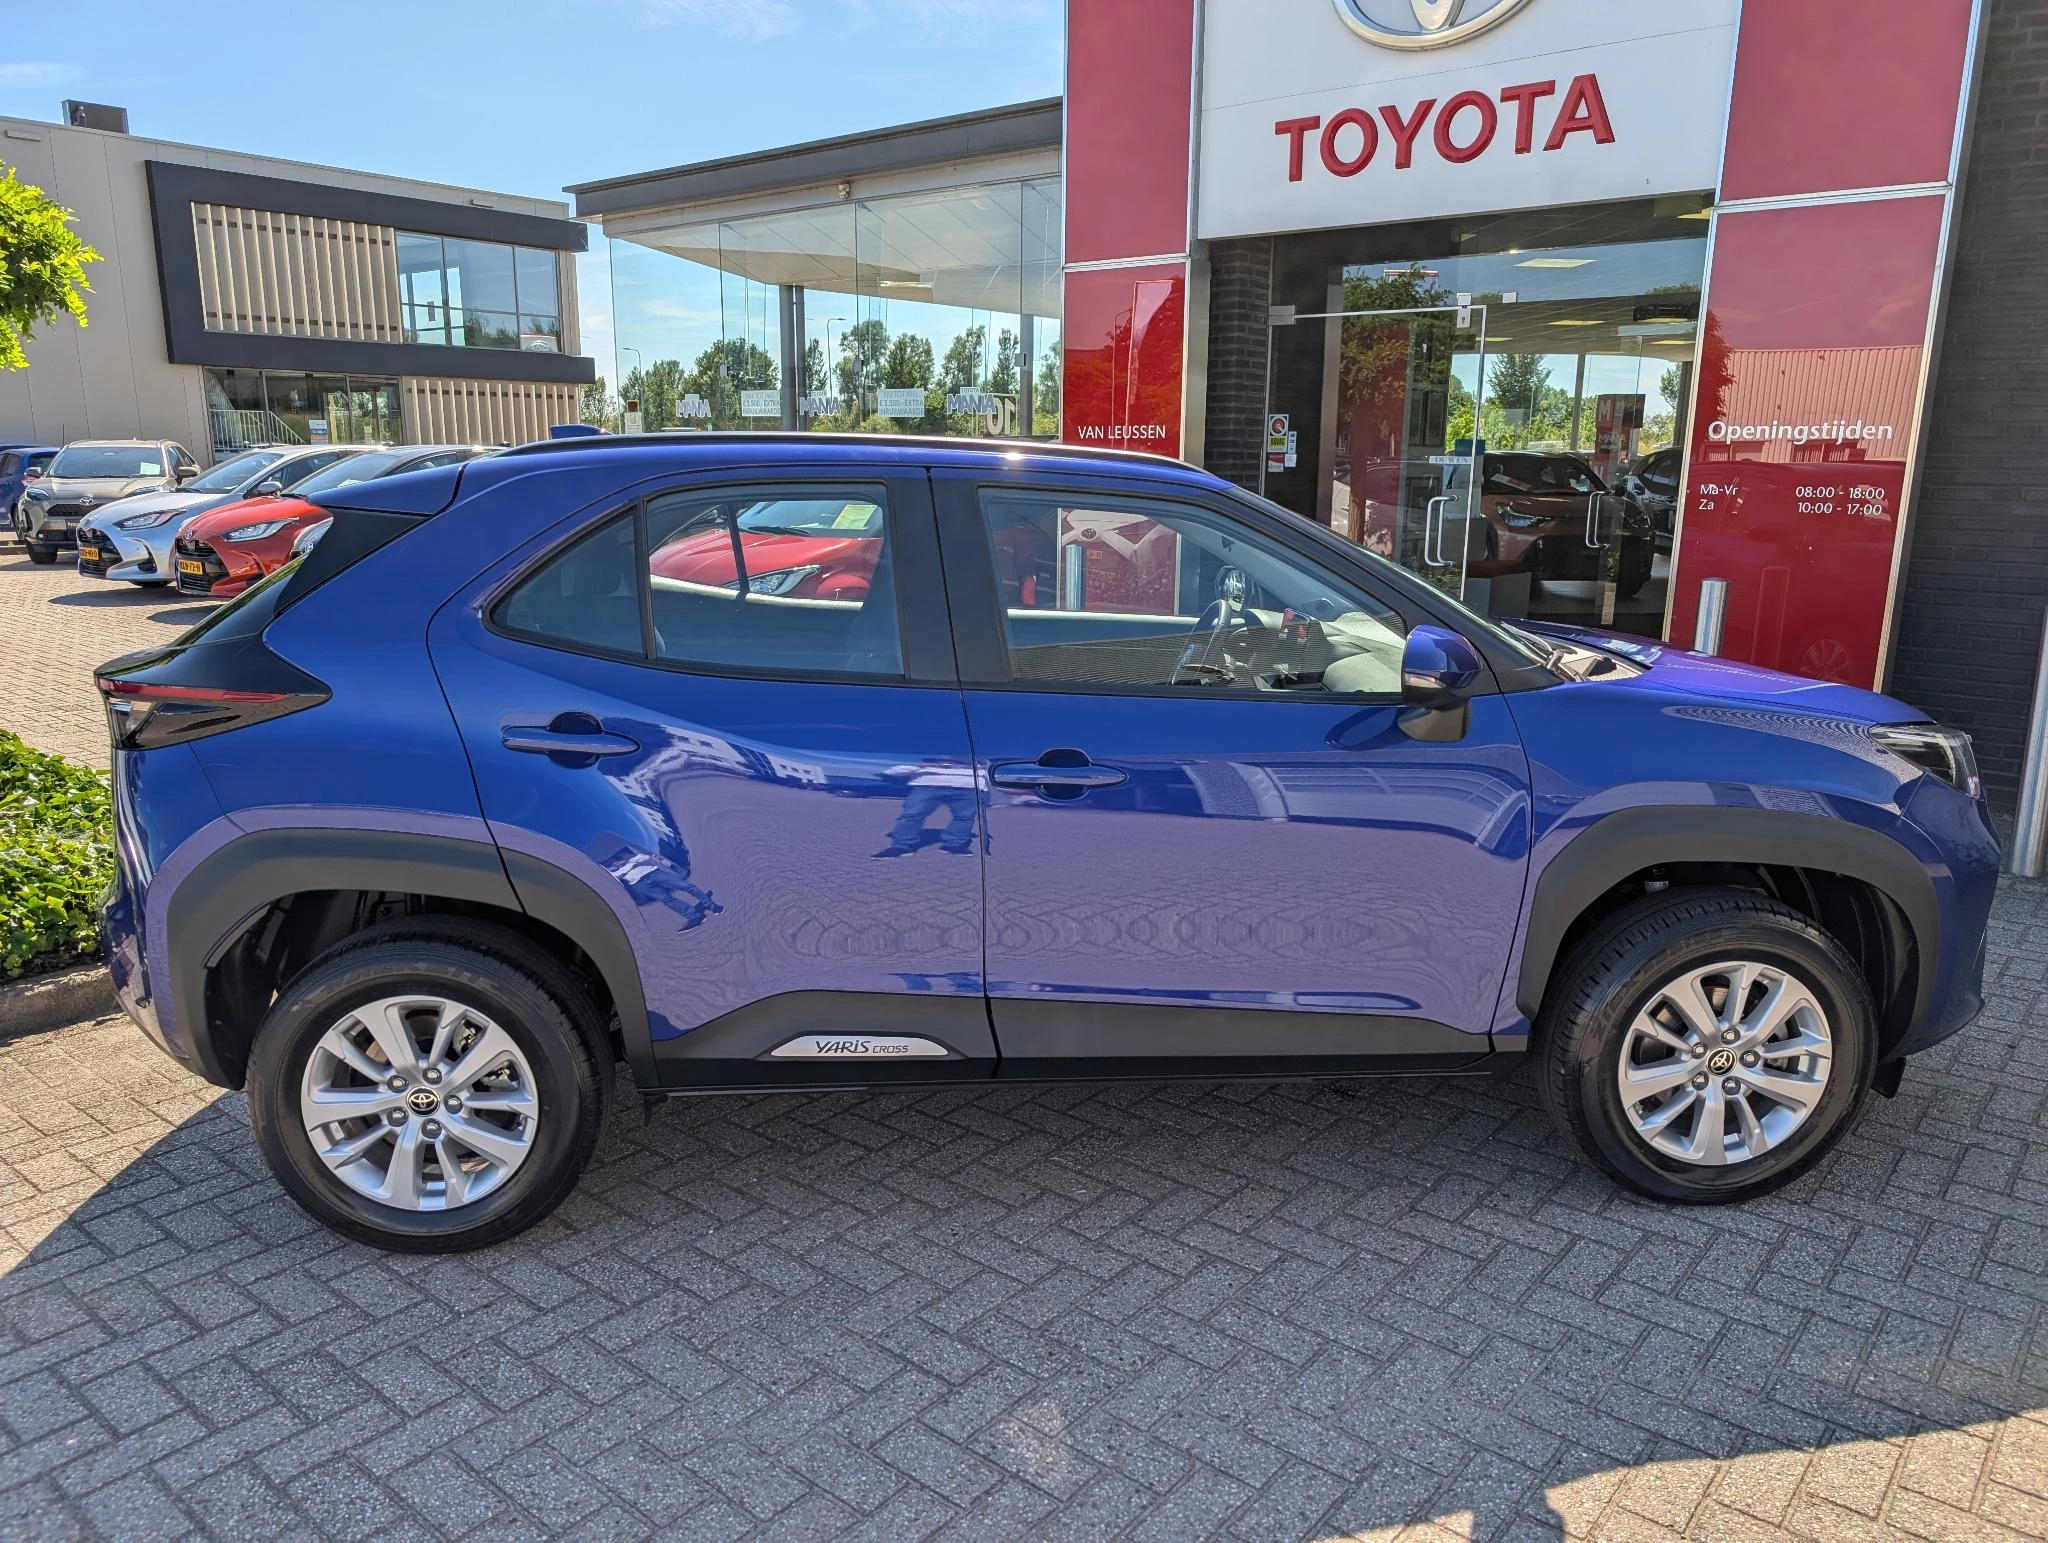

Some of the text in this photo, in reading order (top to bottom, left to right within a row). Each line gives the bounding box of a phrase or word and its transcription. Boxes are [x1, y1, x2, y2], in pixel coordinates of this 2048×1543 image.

[1275, 73, 1615, 182] TOYOTA
[947, 394, 997, 415] MANIA
[1078, 425, 1166, 439] VAN LEUSSEN
[1708, 420, 1893, 445] Openingstijden
[1700, 484, 1738, 496] Ma-Vr
[1795, 486, 1835, 498] 08:00
[1848, 487, 1885, 499] 18:00
[1698, 499, 1714, 510] Za
[1798, 502, 1833, 514] 10:00
[1846, 503, 1883, 515] 17:00
[872, 1045, 909, 1054] CROSS
